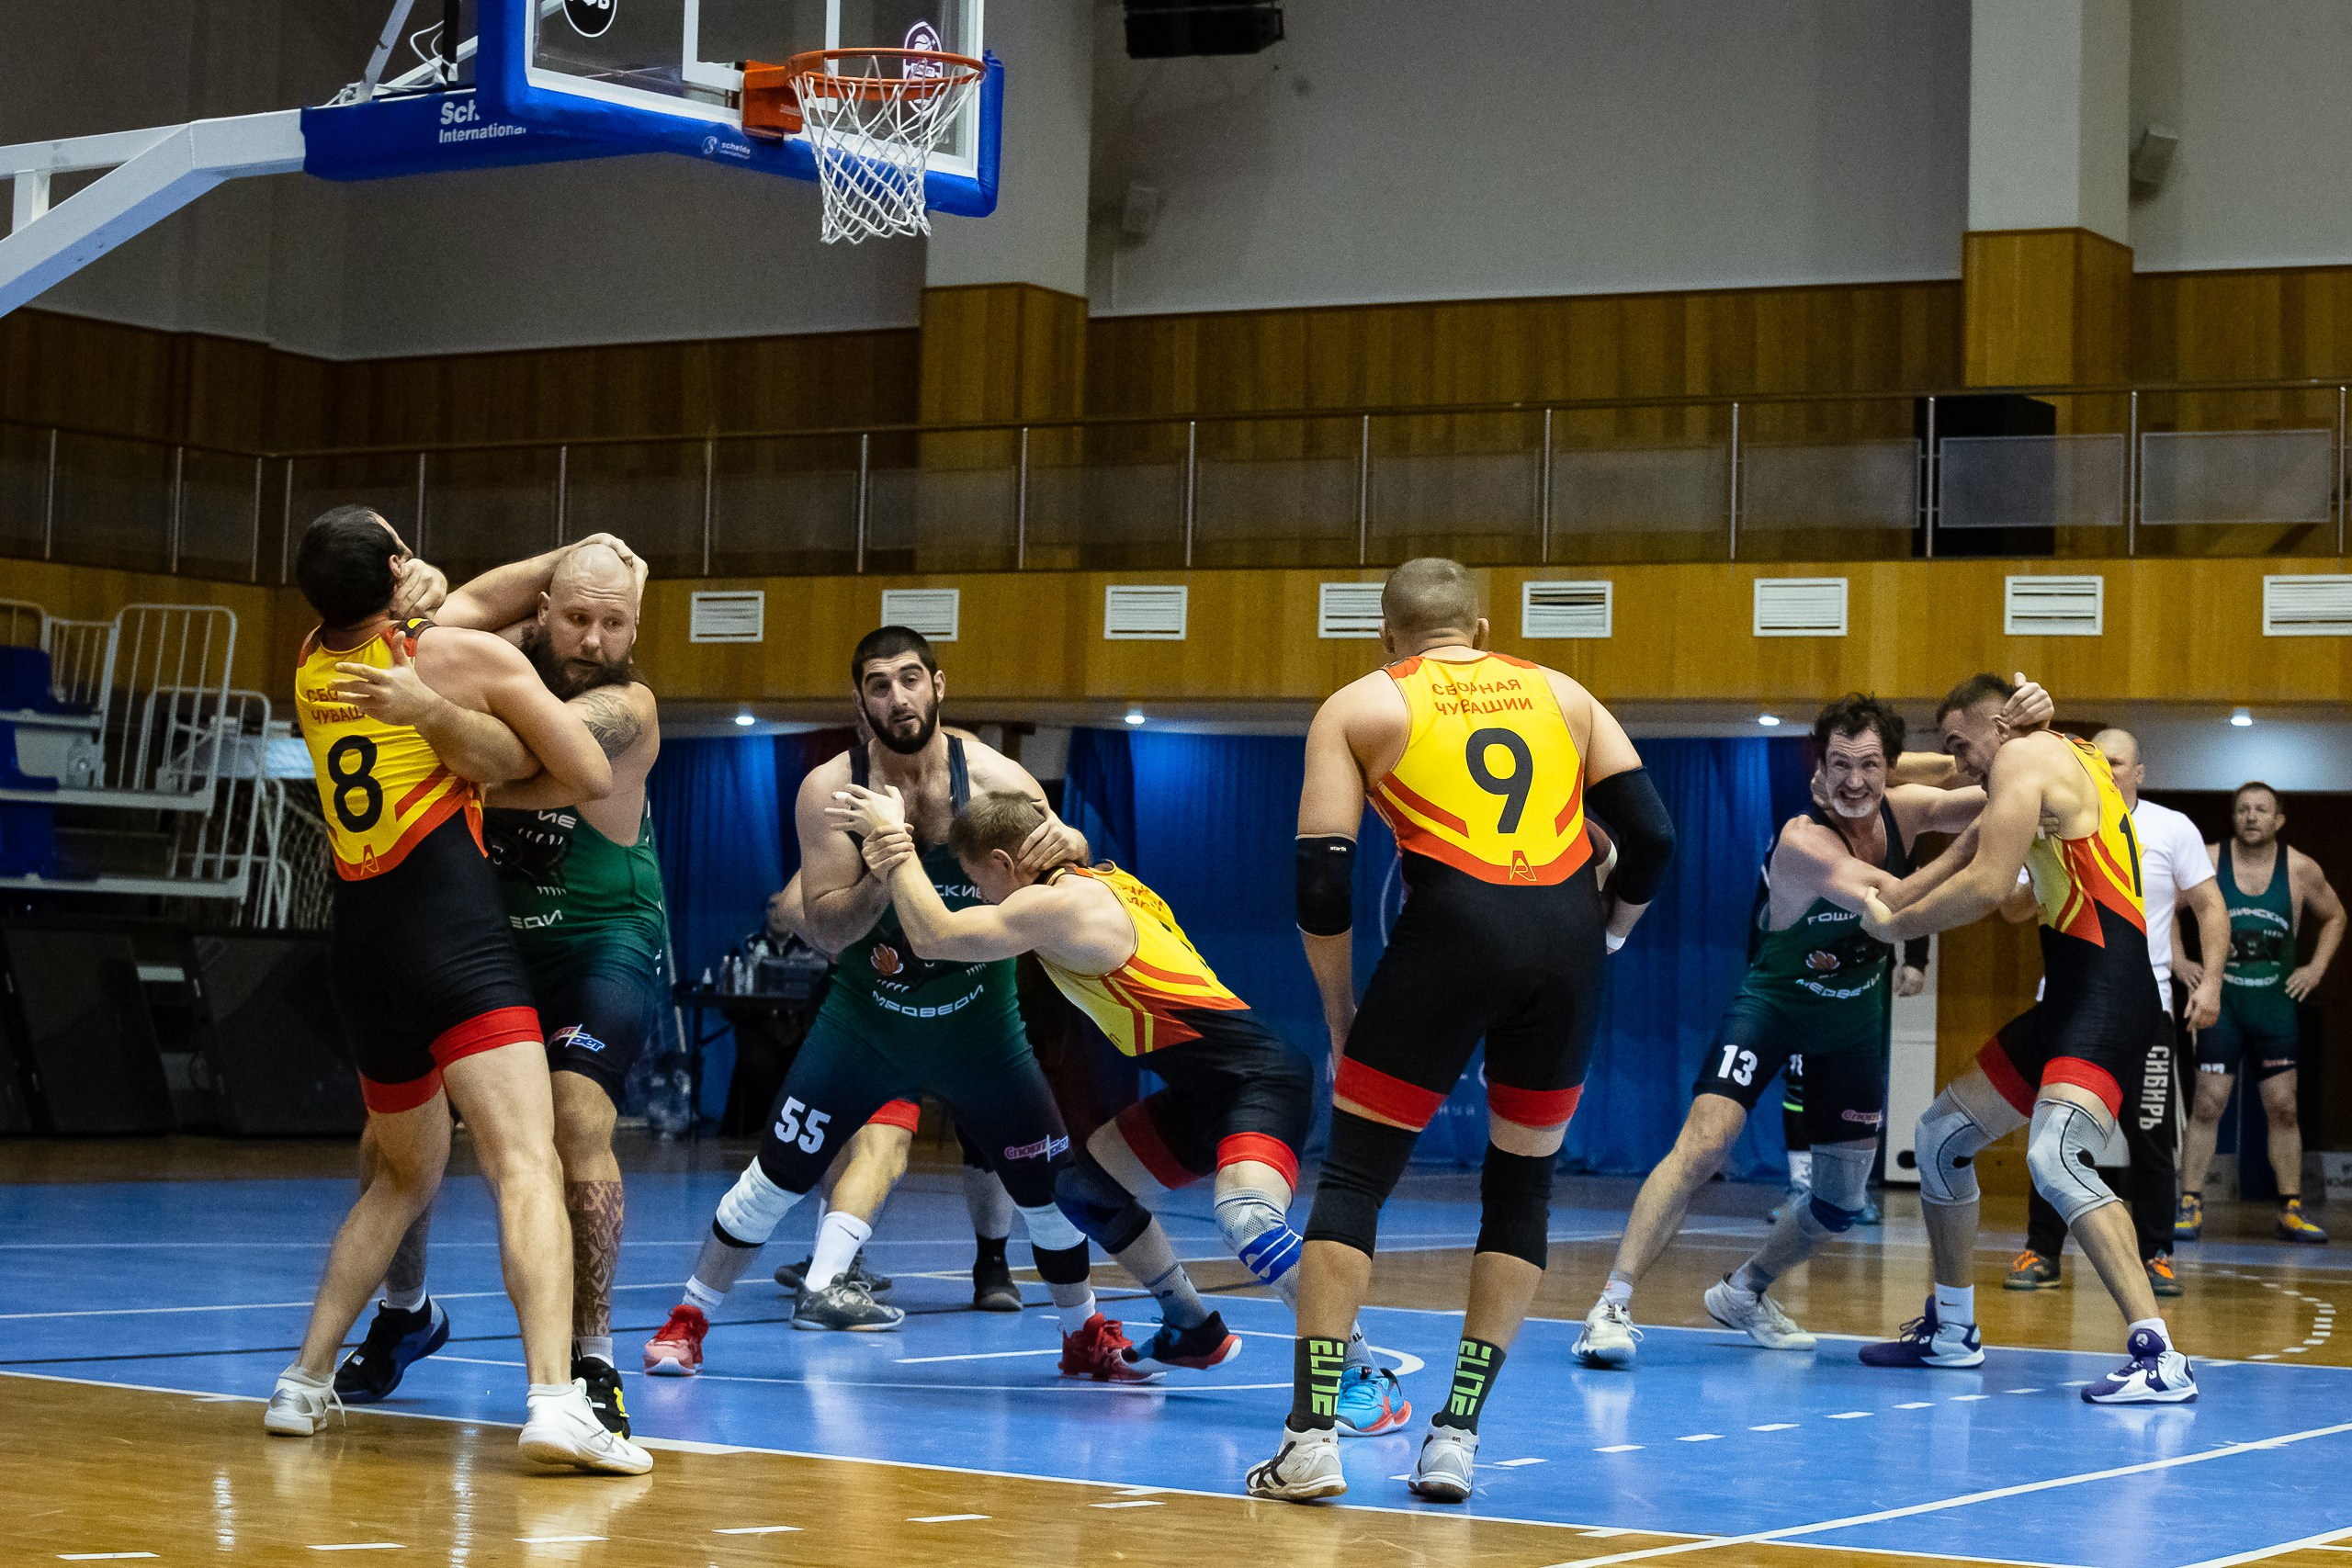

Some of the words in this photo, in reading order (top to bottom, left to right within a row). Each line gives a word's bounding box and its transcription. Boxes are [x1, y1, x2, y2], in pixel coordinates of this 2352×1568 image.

[1431, 679, 1521, 695] СБОРНАЯ
[1434, 697, 1533, 716] ЧУВАШИИ
[327, 735, 383, 833] 8
[1465, 728, 1533, 834] 9
[2119, 813, 2143, 898] 1
[872, 984, 984, 1018] МЕДВЕДИ
[1718, 1044, 1758, 1087] 13
[775, 1096, 831, 1154] 55
[1309, 1339, 1344, 1416] ELITE
[1450, 1339, 1492, 1416] ELITE
